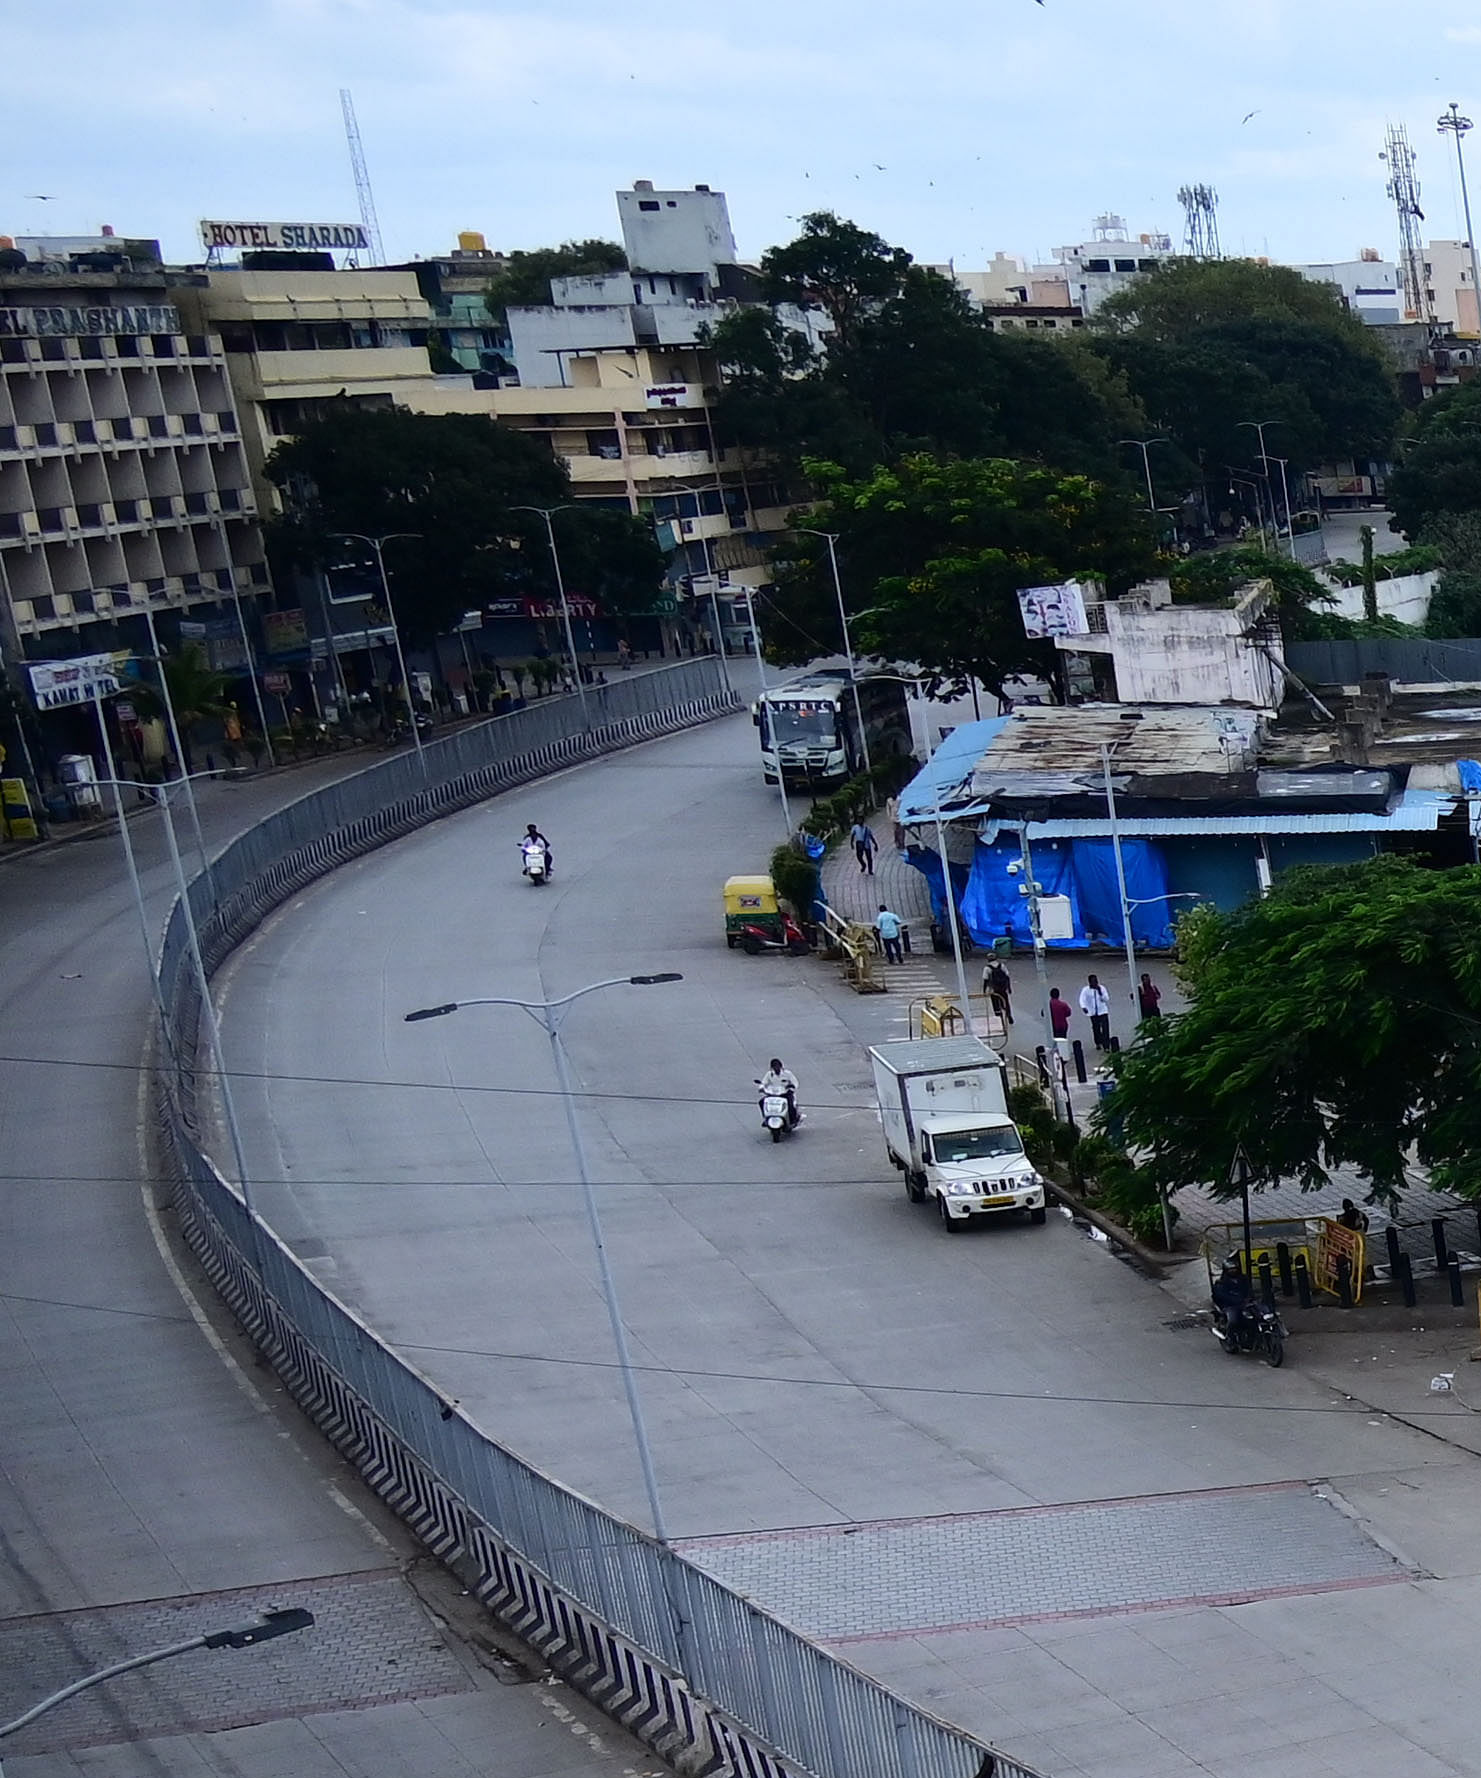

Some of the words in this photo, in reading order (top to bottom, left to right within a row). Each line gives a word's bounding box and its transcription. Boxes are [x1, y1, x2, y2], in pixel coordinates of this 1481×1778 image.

[211, 224, 277, 248] HOTEL
[282, 225, 368, 248] SHARADA
[34, 306, 181, 335] PRASHANTH
[42, 687, 79, 707] KAMAT
[84, 678, 117, 697] HTEL
